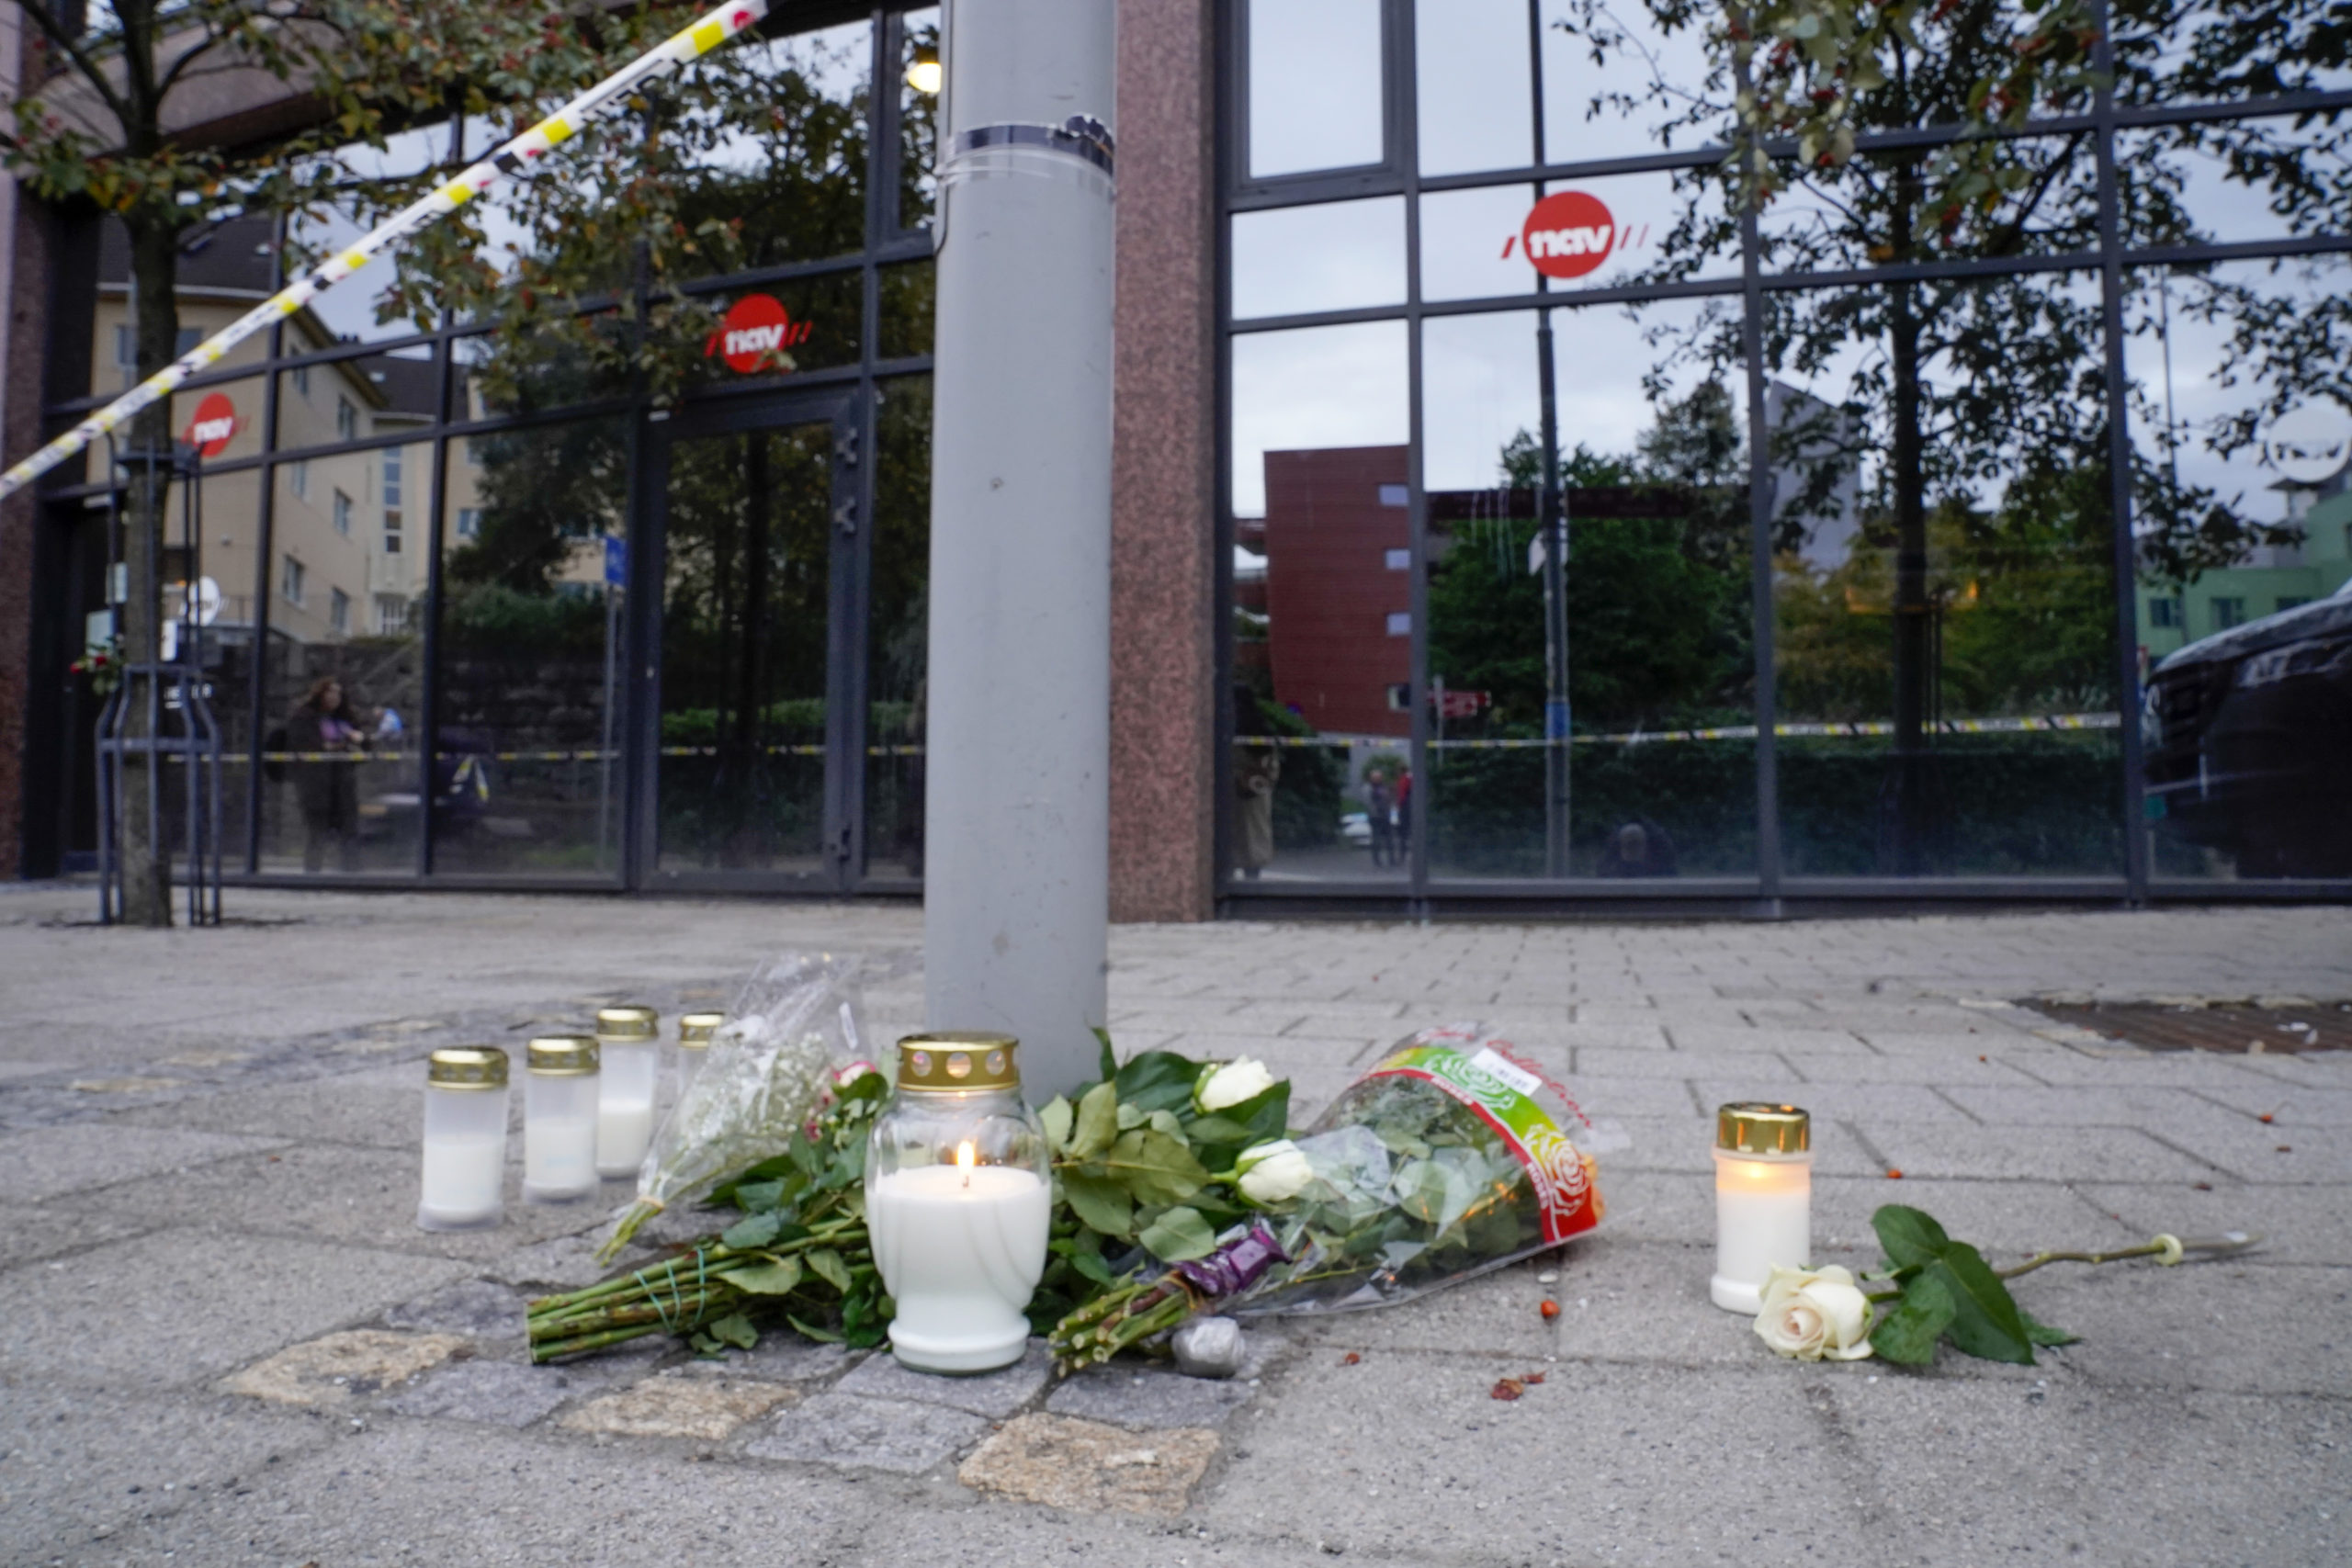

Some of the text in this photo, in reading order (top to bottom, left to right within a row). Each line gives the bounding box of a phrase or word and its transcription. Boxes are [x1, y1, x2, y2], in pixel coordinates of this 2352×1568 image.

[1529, 224, 1611, 259] nav
[725, 323, 786, 355] nav
[1525, 1161, 1550, 1211] ROSES
